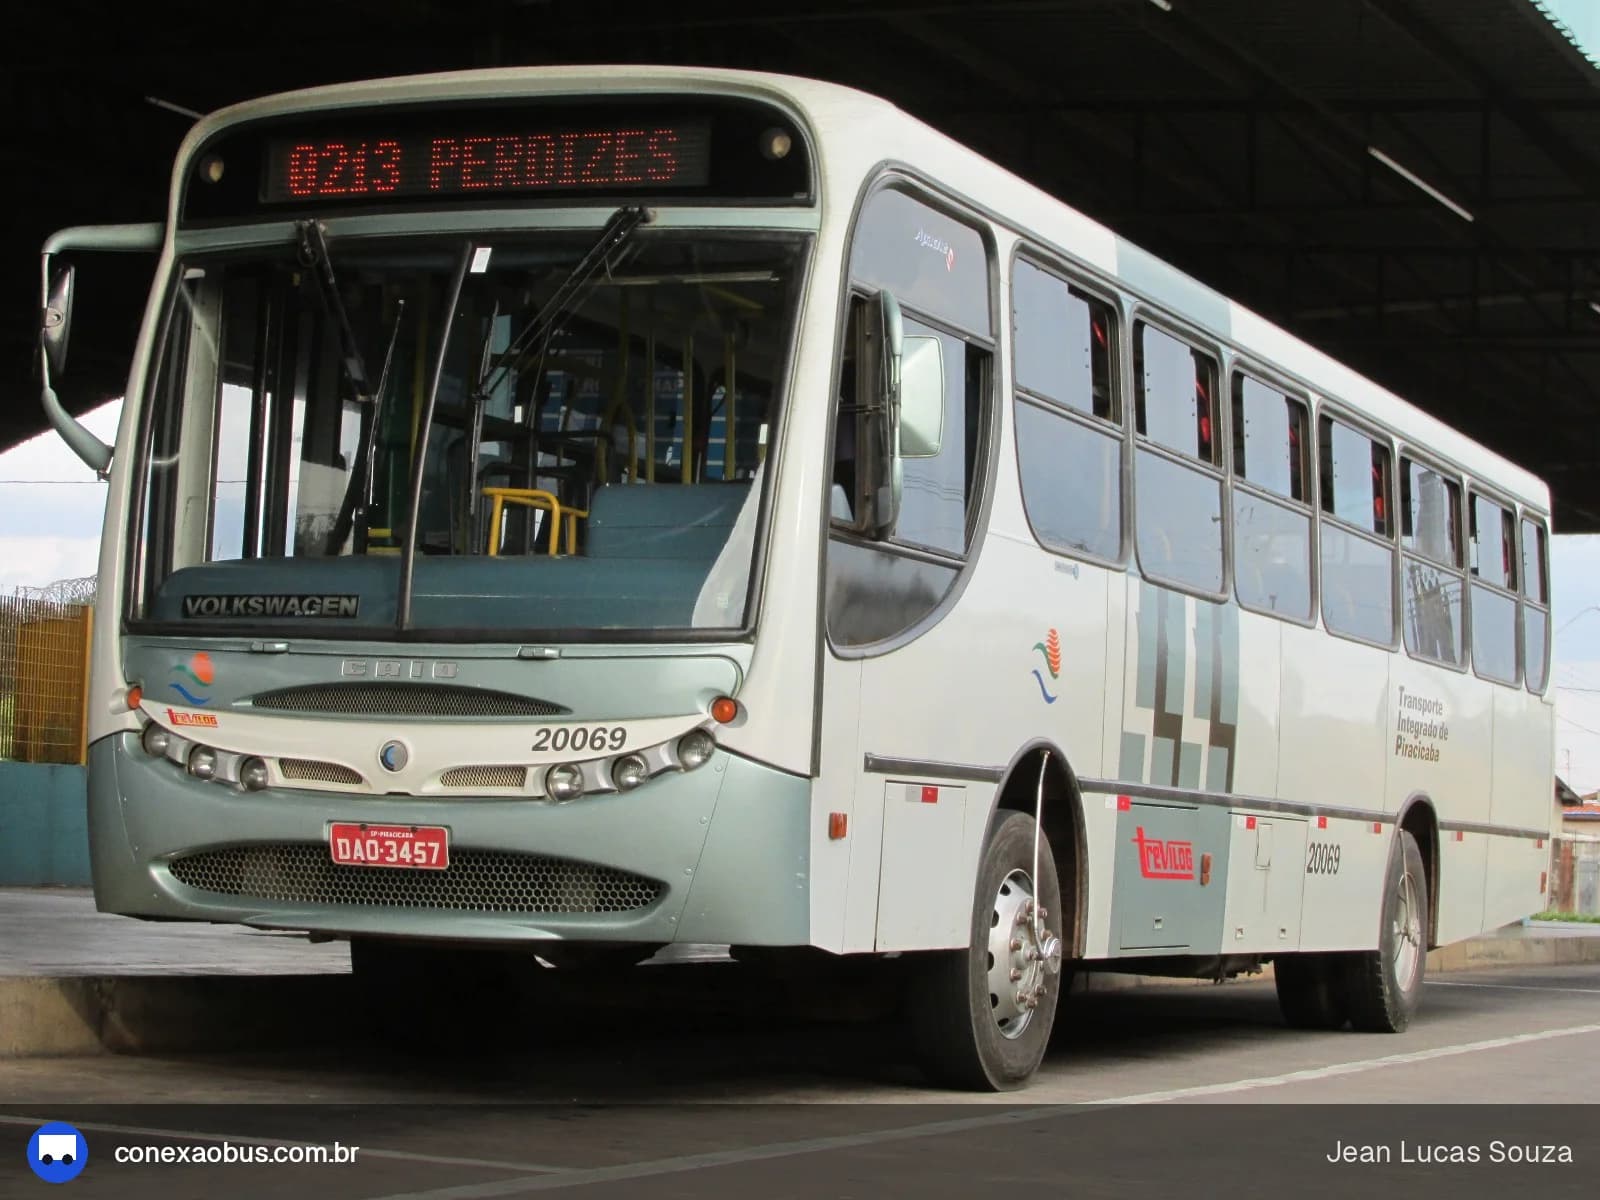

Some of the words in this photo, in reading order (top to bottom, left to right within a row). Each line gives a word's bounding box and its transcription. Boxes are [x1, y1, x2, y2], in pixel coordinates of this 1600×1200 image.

[289, 142, 401, 196] 0213
[429, 128, 680, 190] PERDIZES
[185, 596, 357, 616] VOLKSWAGEN
[341, 659, 459, 679] CAIO
[1398, 685, 1443, 716] Transporte
[531, 727, 627, 752] 20069
[1397, 709, 1438, 739] Integrado
[1439, 722, 1448, 741] de
[1395, 734, 1440, 762] Piracicaba
[1306, 842, 1341, 875] 20069
